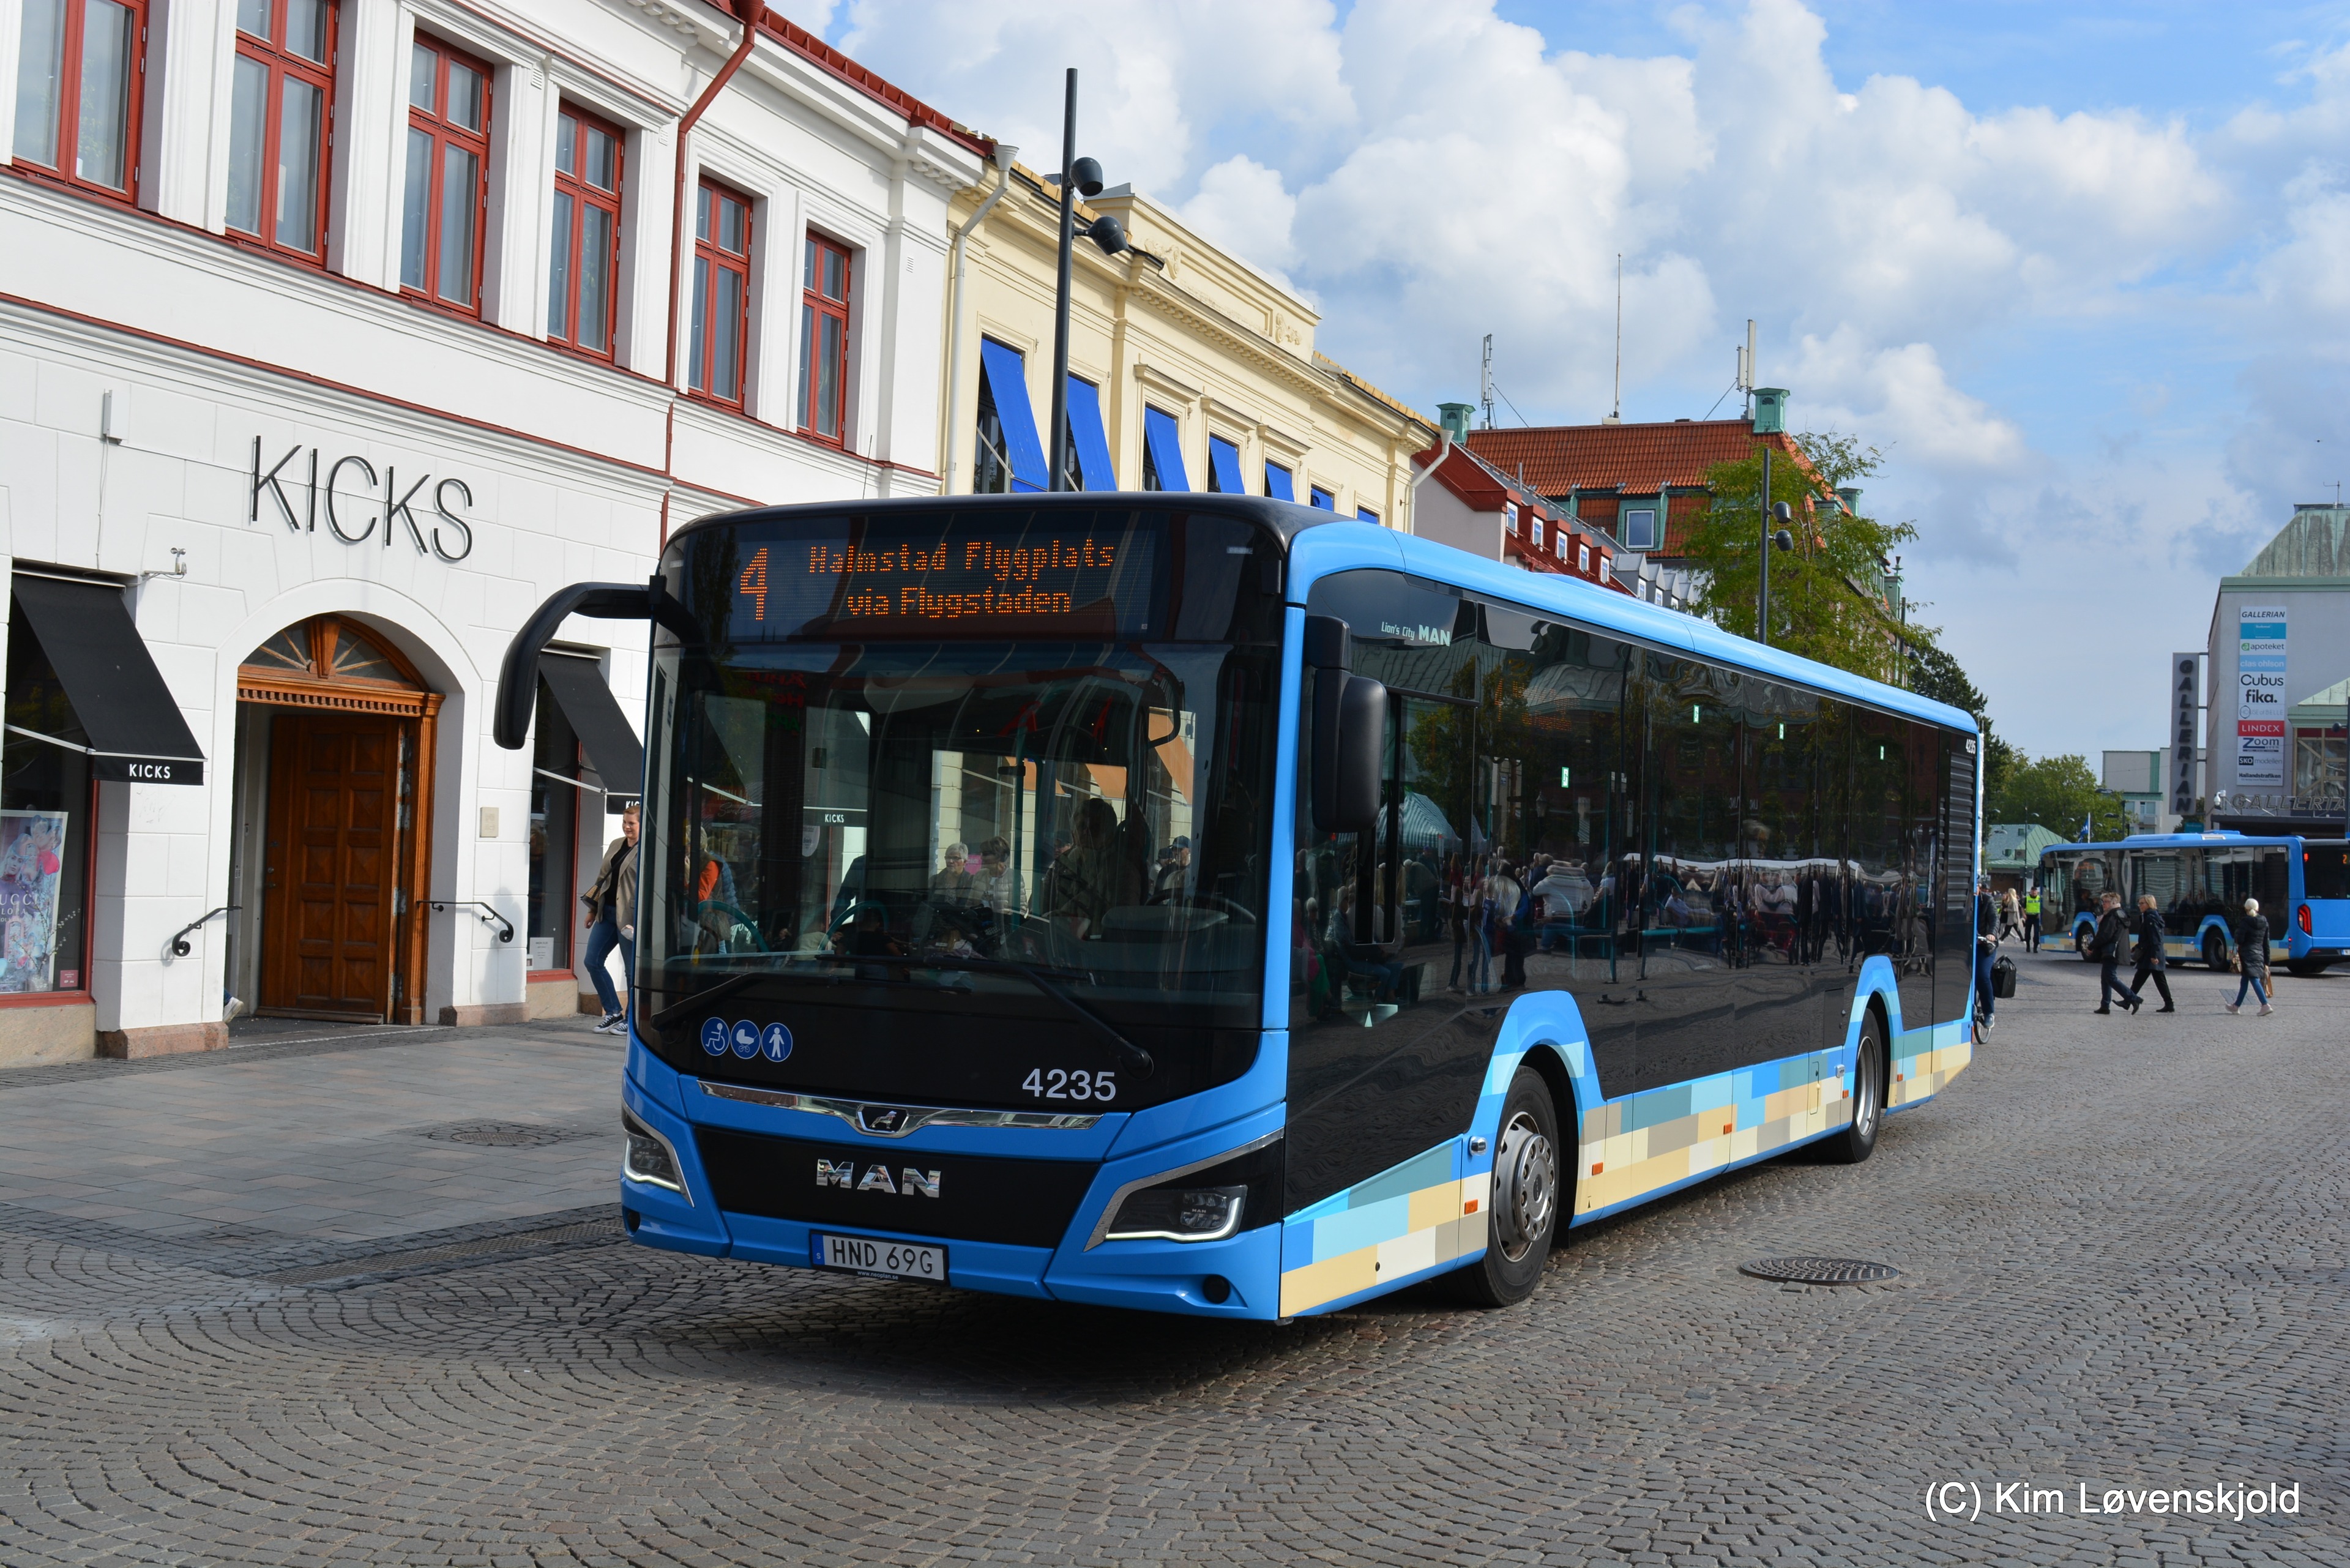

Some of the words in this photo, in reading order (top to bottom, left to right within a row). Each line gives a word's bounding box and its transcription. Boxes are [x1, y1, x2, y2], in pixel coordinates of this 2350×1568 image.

[252, 435, 473, 561] KICKS
[740, 547, 767, 620] 4
[809, 543, 946, 573] Halmstad
[965, 539, 1114, 580] Flygplats
[847, 588, 889, 614] via
[900, 585, 1071, 618] Flygstaden
[1381, 621, 1400, 635] Lion's
[1402, 626, 1415, 641] City
[1419, 624, 1450, 647] MAN
[2250, 643, 2285, 651] apoteket
[2240, 673, 2284, 686] Cubus
[2245, 689, 2278, 703] fika.
[2176, 659, 2194, 812] GALLERIAN
[2243, 737, 2279, 749] Zoom
[1965, 738, 1976, 755] 4235
[129, 763, 171, 779] KICKS
[2231, 793, 2346, 811] GALLERIA
[824, 813, 845, 823] KICKS
[0, 893, 37, 905] UCCI
[1021, 1068, 1116, 1102] 4235
[816, 1159, 941, 1198] MAN
[832, 1239, 878, 1267] HND
[886, 1246, 933, 1274] 69G
[857, 1271, 898, 1280] www.neoplan.se
